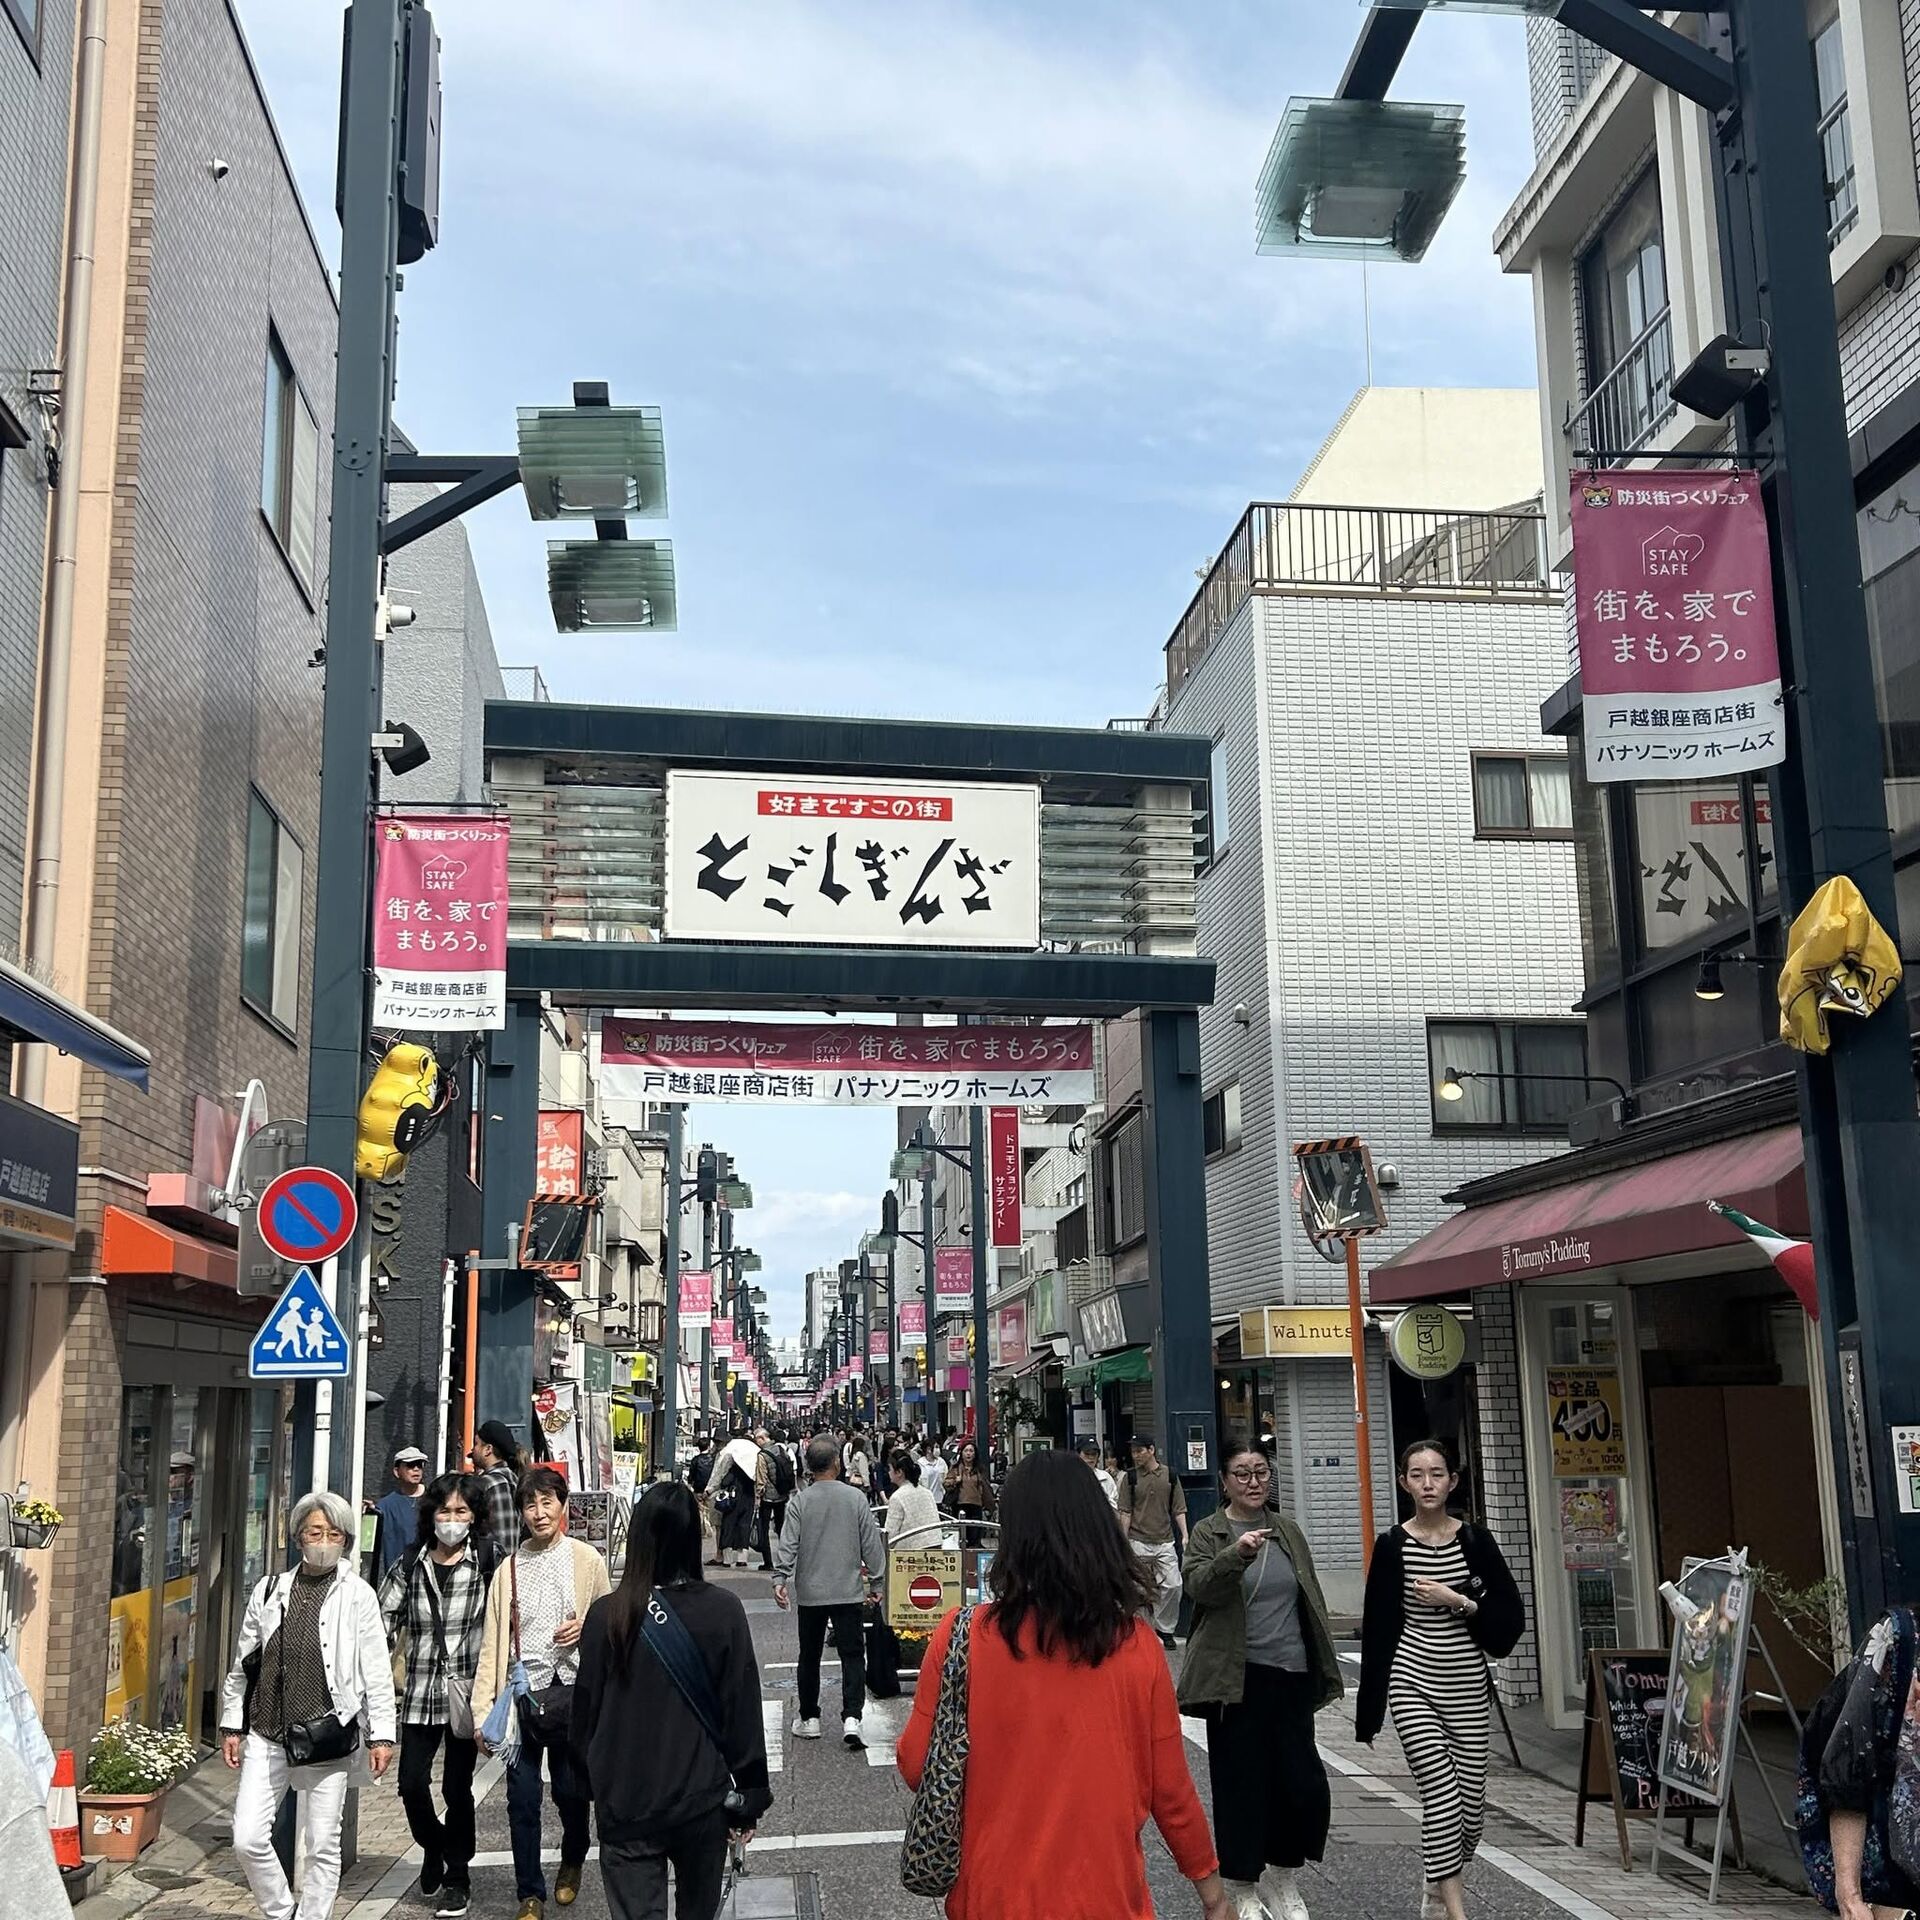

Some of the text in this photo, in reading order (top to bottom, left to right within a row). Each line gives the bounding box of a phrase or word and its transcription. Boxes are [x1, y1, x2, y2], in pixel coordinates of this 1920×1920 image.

[1617, 489, 1749, 506] 防災街づくりフェア
[1649, 549, 1689, 562] STAY
[1649, 563, 1689, 576] SAFE
[1593, 589, 1756, 622] 街を、家で
[1611, 633, 1747, 663] まもろう。
[1608, 702, 1755, 728] 戸越銀座商店街
[1597, 730, 1775, 763] パナソニック ホームズ
[768, 793, 942, 818] 好きですこの街
[406, 828, 501, 843] 防災街づくりフェア
[426, 871, 455, 880] STAY
[426, 880, 455, 890] SAFE
[696, 831, 1012, 925] とごしぎんざ
[387, 898, 497, 922] 街を、家で
[396, 930, 487, 952] まもろう。
[391, 980, 488, 996] 戸越銀座商店街
[383, 1004, 497, 1019] パナソニック ホームズ
[655, 1033, 787, 1055] 防災街づくりフェア
[815, 1045, 842, 1054] STAY
[859, 1034, 1080, 1062] 街を、家でまもろう。
[815, 1054, 842, 1063] SAFE
[643, 1072, 814, 1097] 戸越銀座商店街
[834, 1075, 1051, 1099] パナソニック ホームズ
[1005, 1135, 1017, 1205] ドコモショップ
[995, 1176, 1006, 1229] サテライト
[1512, 1237, 1592, 1272] Tommy's Pudding
[1273, 1323, 1353, 1340] Walnuts
[1569, 1380, 1600, 1398] 全品
[1609, 1699, 1639, 1711] Which
[1617, 1712, 1647, 1723] do you
